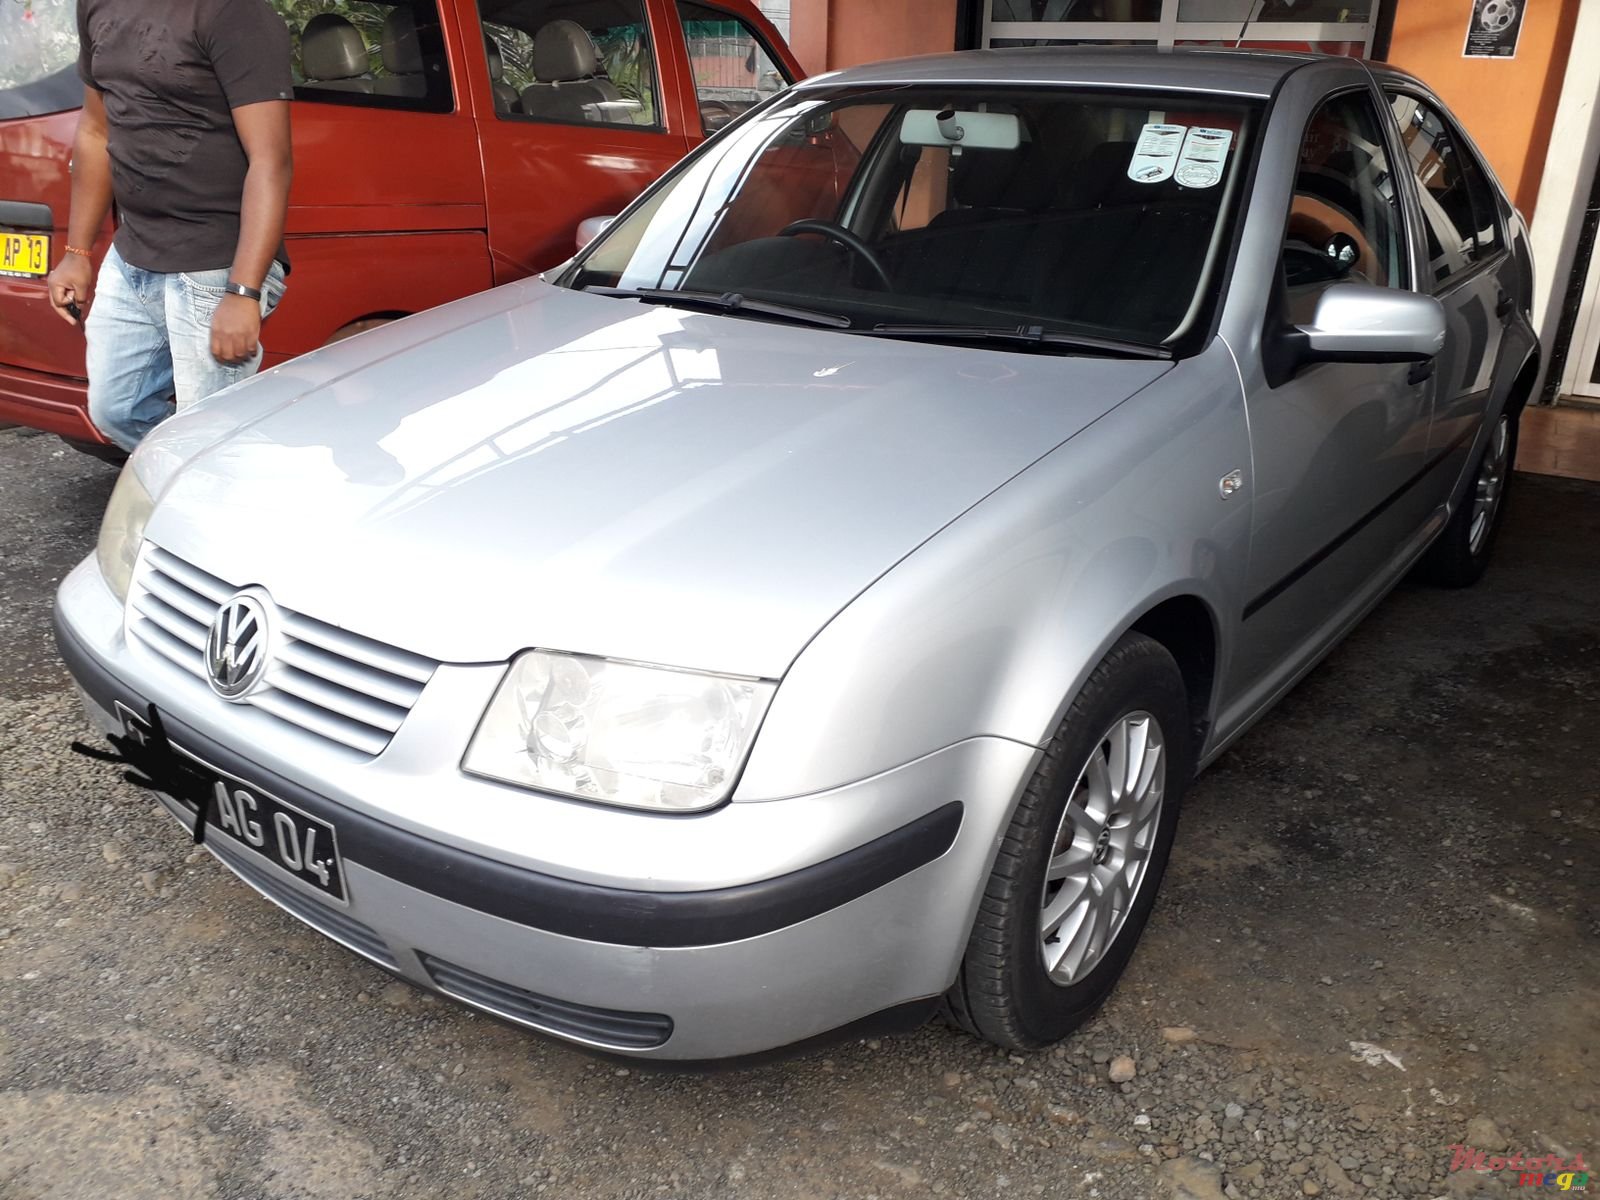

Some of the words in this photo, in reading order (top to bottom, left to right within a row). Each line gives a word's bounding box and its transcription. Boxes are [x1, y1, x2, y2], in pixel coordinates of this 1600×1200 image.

[3, 237, 21, 267] AP
[214, 781, 264, 847] AG
[273, 811, 330, 887] 04
